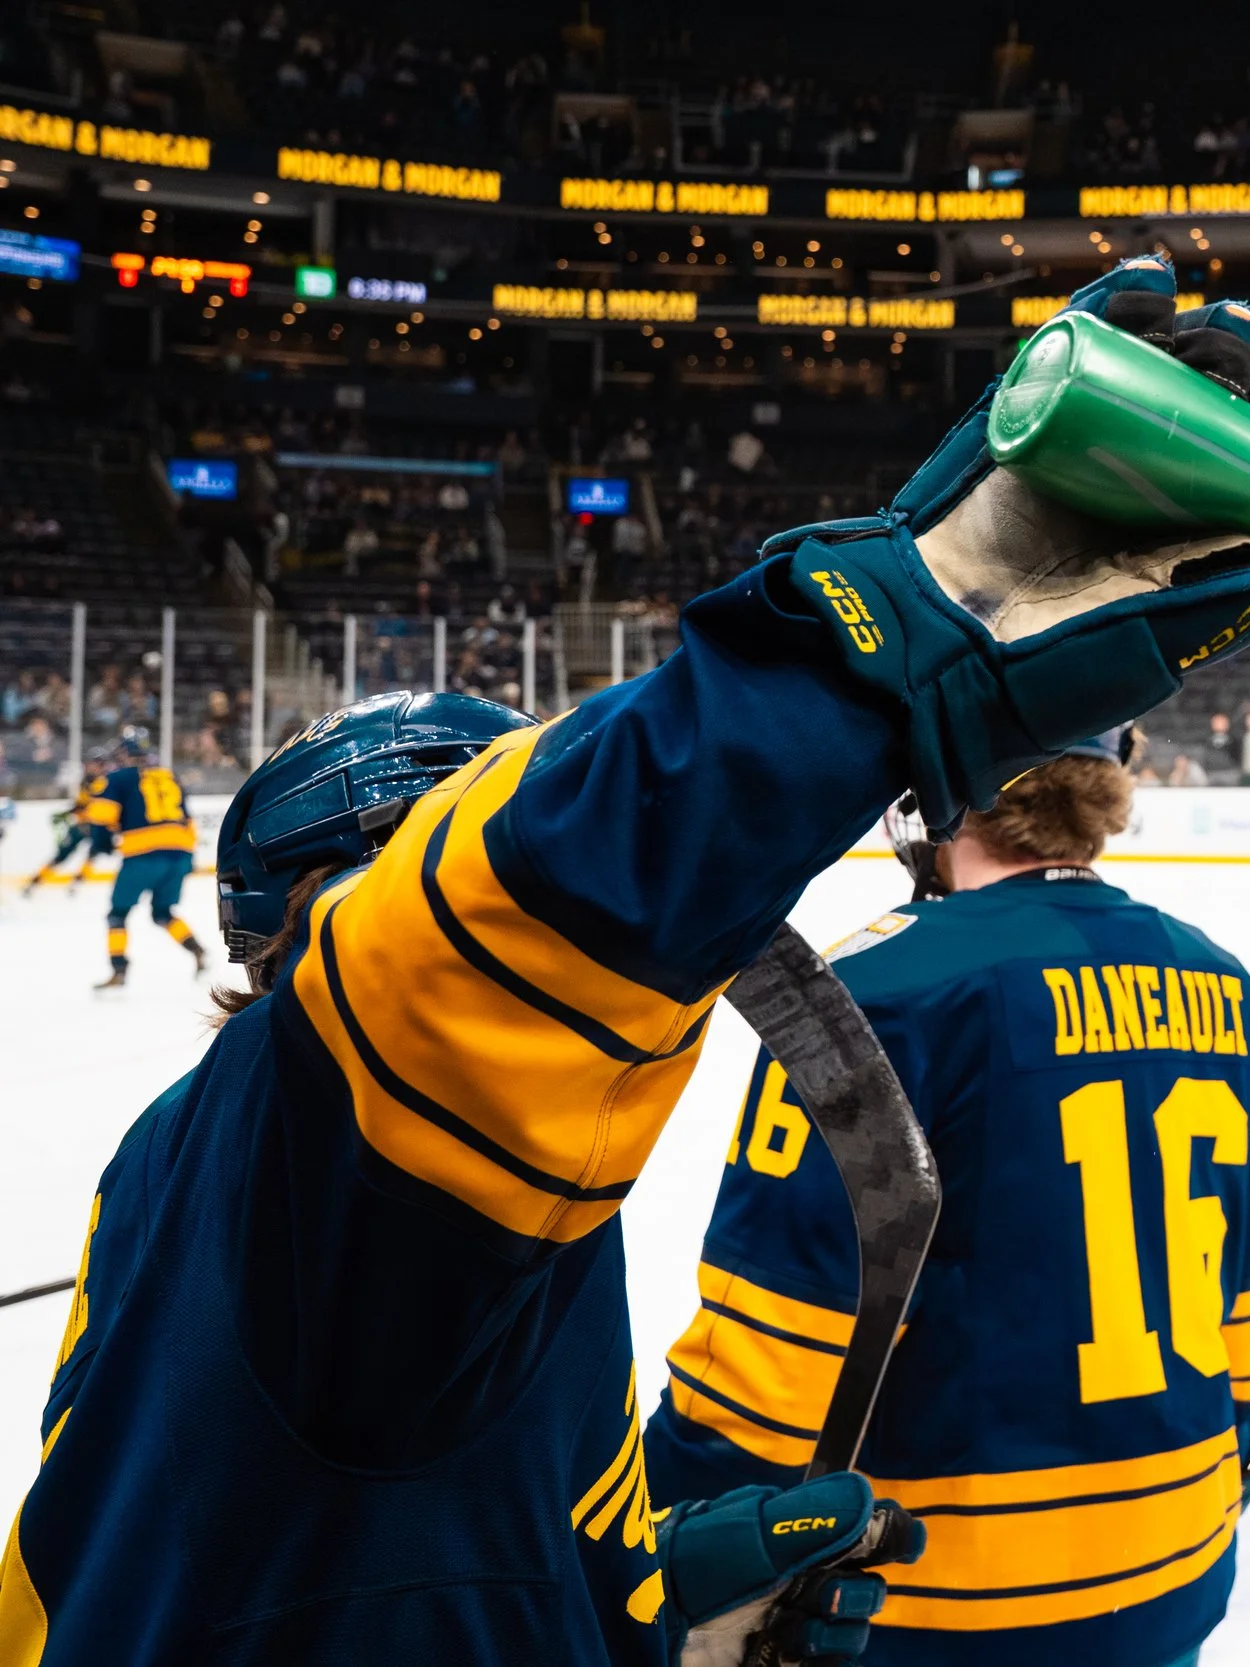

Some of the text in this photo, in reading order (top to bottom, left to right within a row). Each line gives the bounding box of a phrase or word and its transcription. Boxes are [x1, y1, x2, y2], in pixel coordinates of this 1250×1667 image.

[0, 105, 73, 152] RGAN
[100, 126, 210, 170] MORGAN
[278, 147, 380, 189] MORGAN
[403, 162, 501, 202] MORGAN
[561, 178, 654, 211] MORGAN
[676, 182, 769, 216] MORGAN
[826, 189, 916, 221] MORGAN
[937, 189, 1025, 221] MORGAN
[809, 570, 877, 653] CCM
[1043, 964, 1249, 1057] DANEAULT
[1058, 1076, 1249, 1405] 16
[771, 1515, 837, 1535] CCM
